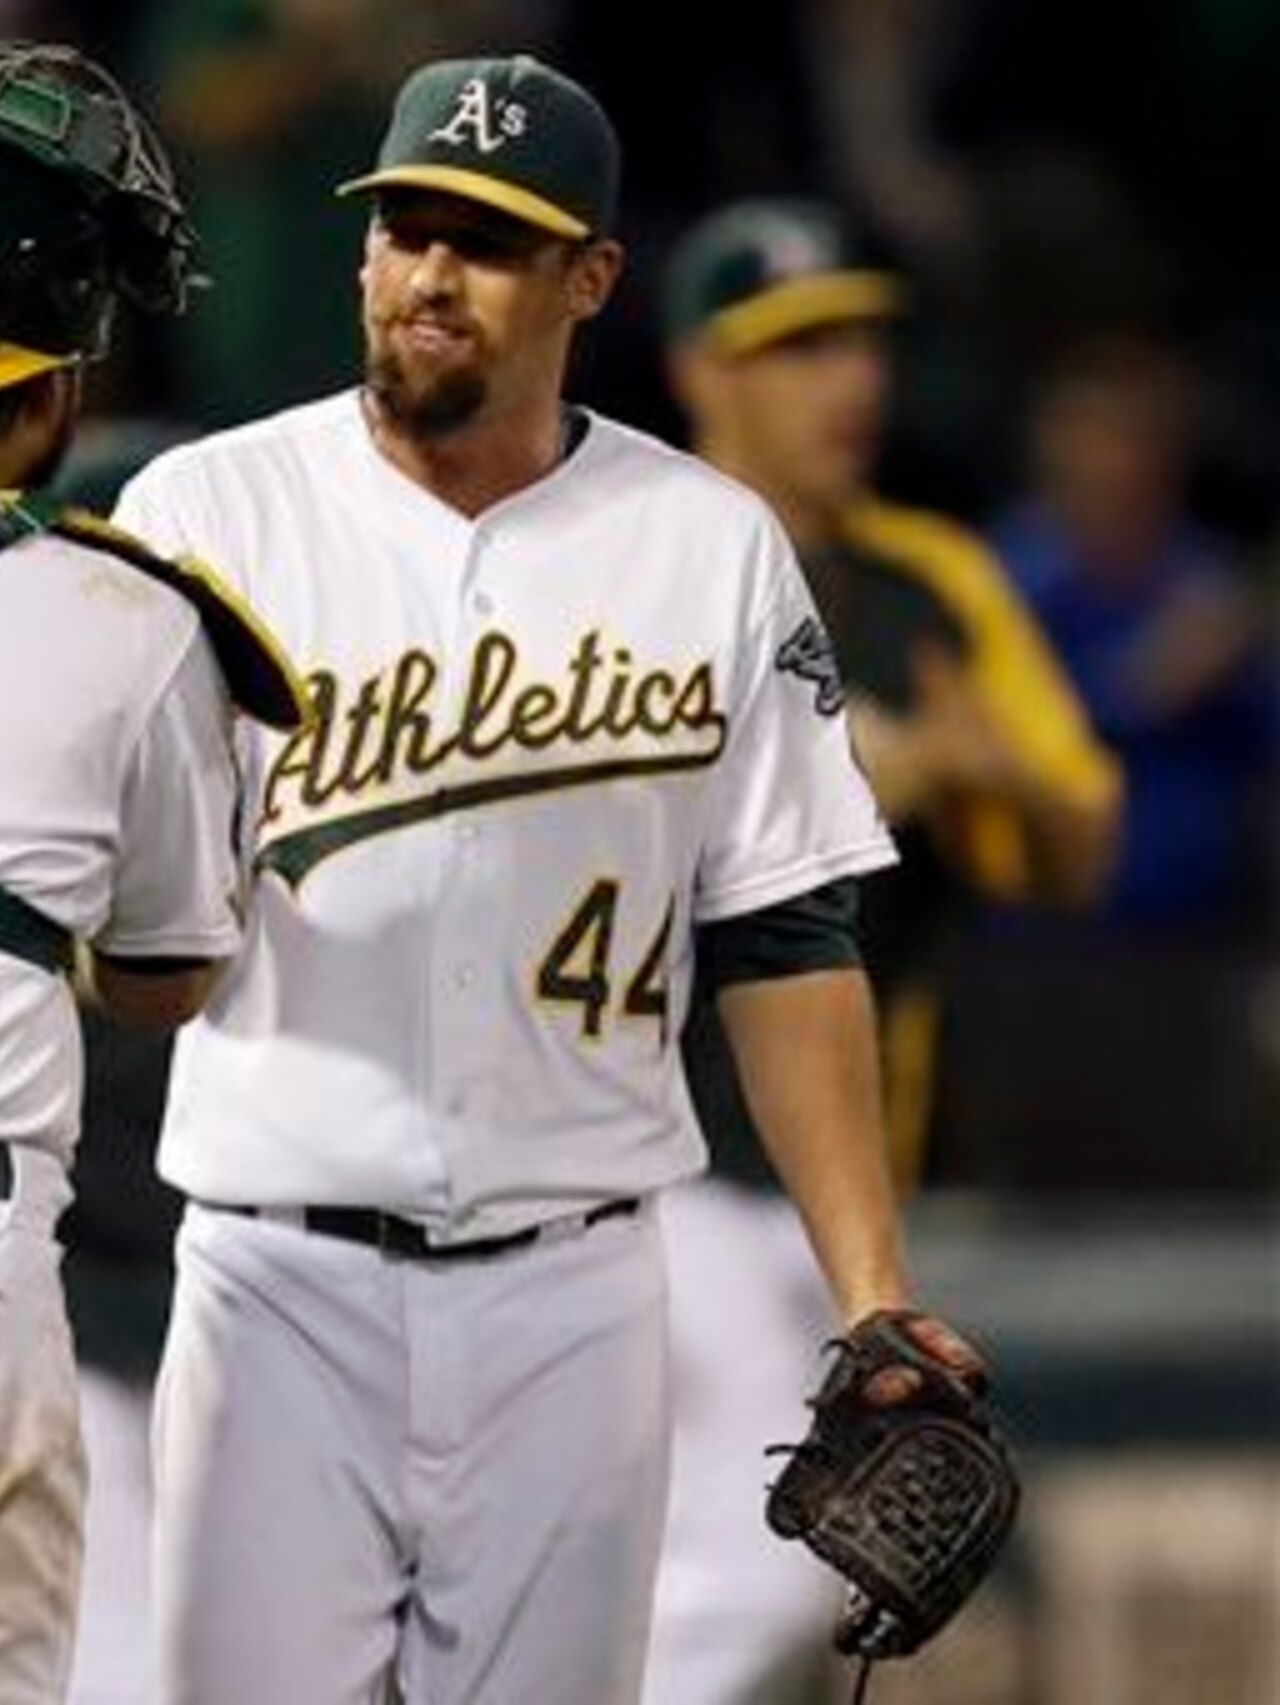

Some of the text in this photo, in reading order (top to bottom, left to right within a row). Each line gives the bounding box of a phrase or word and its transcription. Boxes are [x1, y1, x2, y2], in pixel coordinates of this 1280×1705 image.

[426, 78, 527, 152] A's
[258, 628, 728, 830] Athletics
[534, 876, 672, 1052] 44
